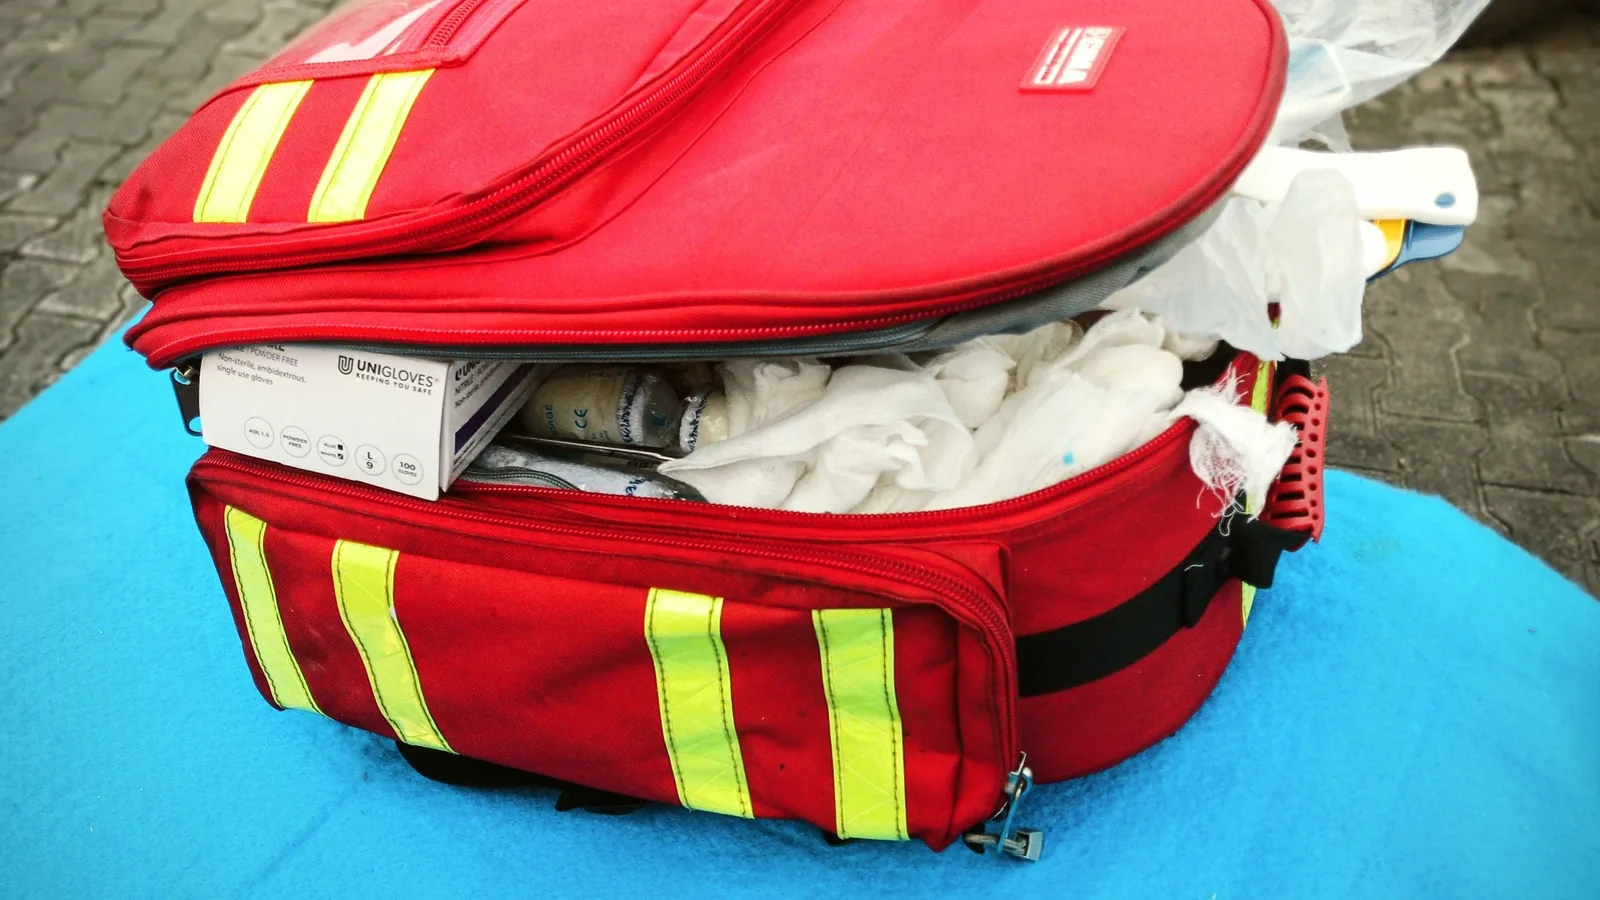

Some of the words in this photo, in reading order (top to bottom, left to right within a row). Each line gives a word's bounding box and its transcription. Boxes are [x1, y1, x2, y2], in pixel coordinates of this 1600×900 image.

[251, 347, 280, 361] POWDER
[282, 355, 299, 367] FREE
[217, 365, 237, 376] single
[238, 371, 250, 379] use
[251, 374, 273, 385] gloves
[357, 359, 434, 388] UNIGLOVES
[356, 373, 391, 386] KEEPING
[393, 381, 410, 391] YOU
[412, 386, 432, 396] SAFE
[545, 404, 557, 433] DAGE
[573, 409, 588, 429] CE
[283, 434, 308, 445] POWDER
[288, 441, 302, 449] FREE
[367, 451, 374, 460] L
[366, 461, 374, 470] 9
[398, 468, 418, 477] GLOVES
[400, 461, 416, 472] 100
